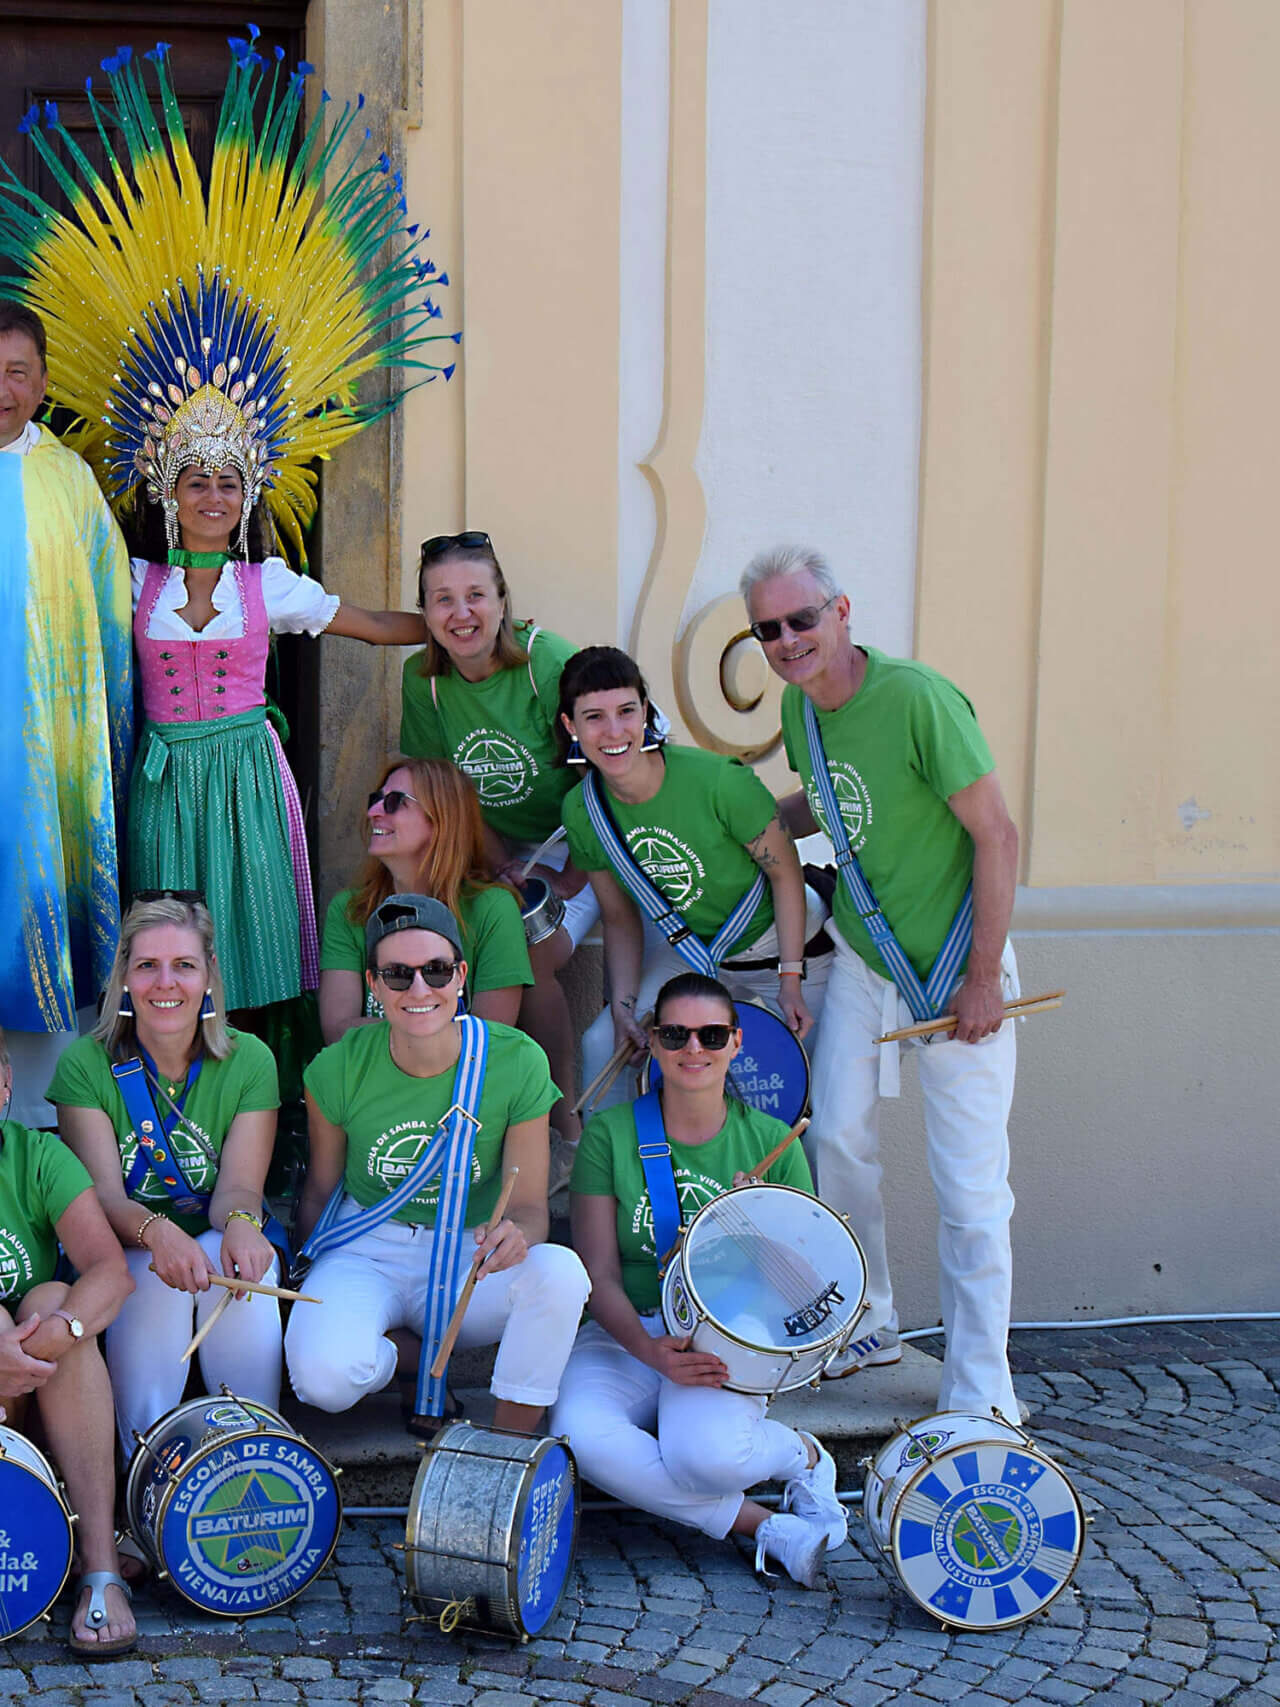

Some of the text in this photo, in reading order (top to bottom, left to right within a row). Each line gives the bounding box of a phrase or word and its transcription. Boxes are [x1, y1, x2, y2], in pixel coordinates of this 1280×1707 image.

[376, 1133, 390, 1147] DE
[389, 1120, 427, 1136] SAMBA
[174, 1450, 237, 1514] ESCOLA
[243, 1443, 271, 1457] DE
[275, 1446, 327, 1501] SAMBA
[195, 1507, 307, 1536] BATURIM
[965, 1503, 1014, 1567] BATURIM
[972, 1486, 1041, 1568] ESCOLA DE SAMBA
